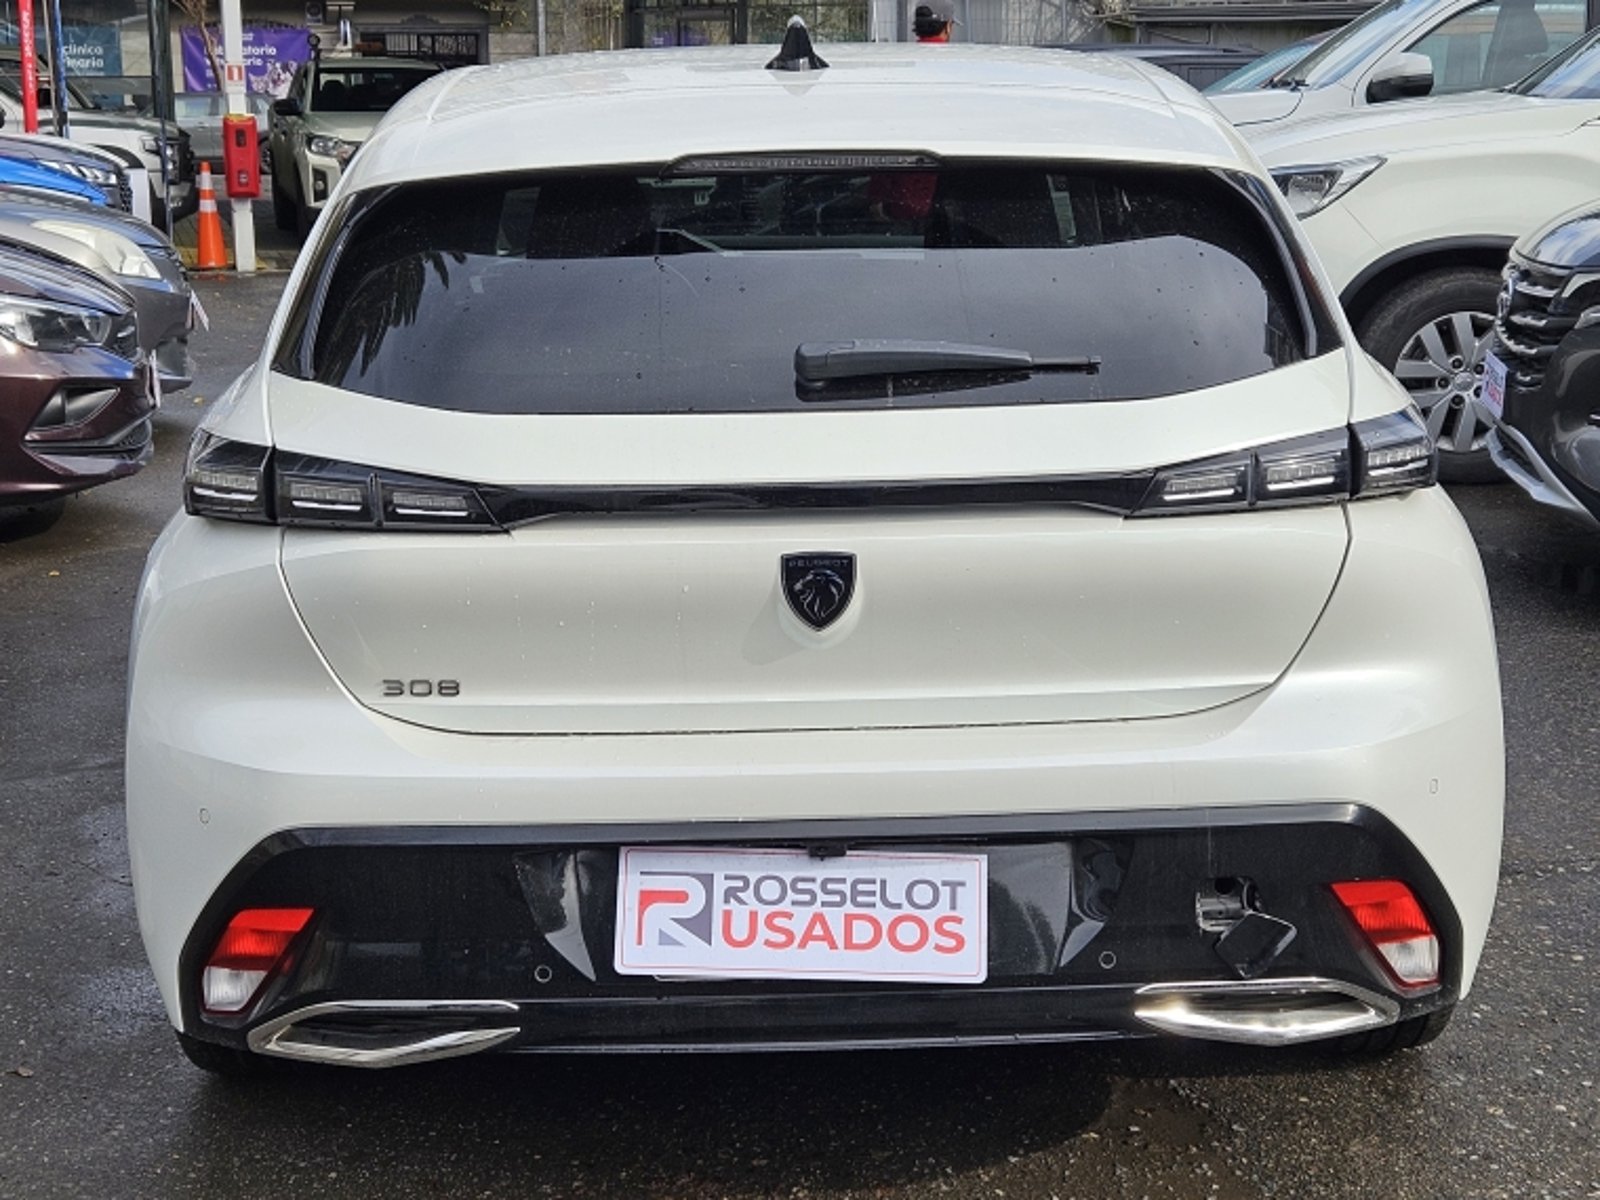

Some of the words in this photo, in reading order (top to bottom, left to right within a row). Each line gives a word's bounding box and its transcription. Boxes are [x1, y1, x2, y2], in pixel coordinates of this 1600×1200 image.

[788, 559, 849, 567] PEUGEOT
[382, 679, 460, 697] 308
[722, 873, 967, 911] ROSSELOT
[721, 909, 966, 955] USADOS
